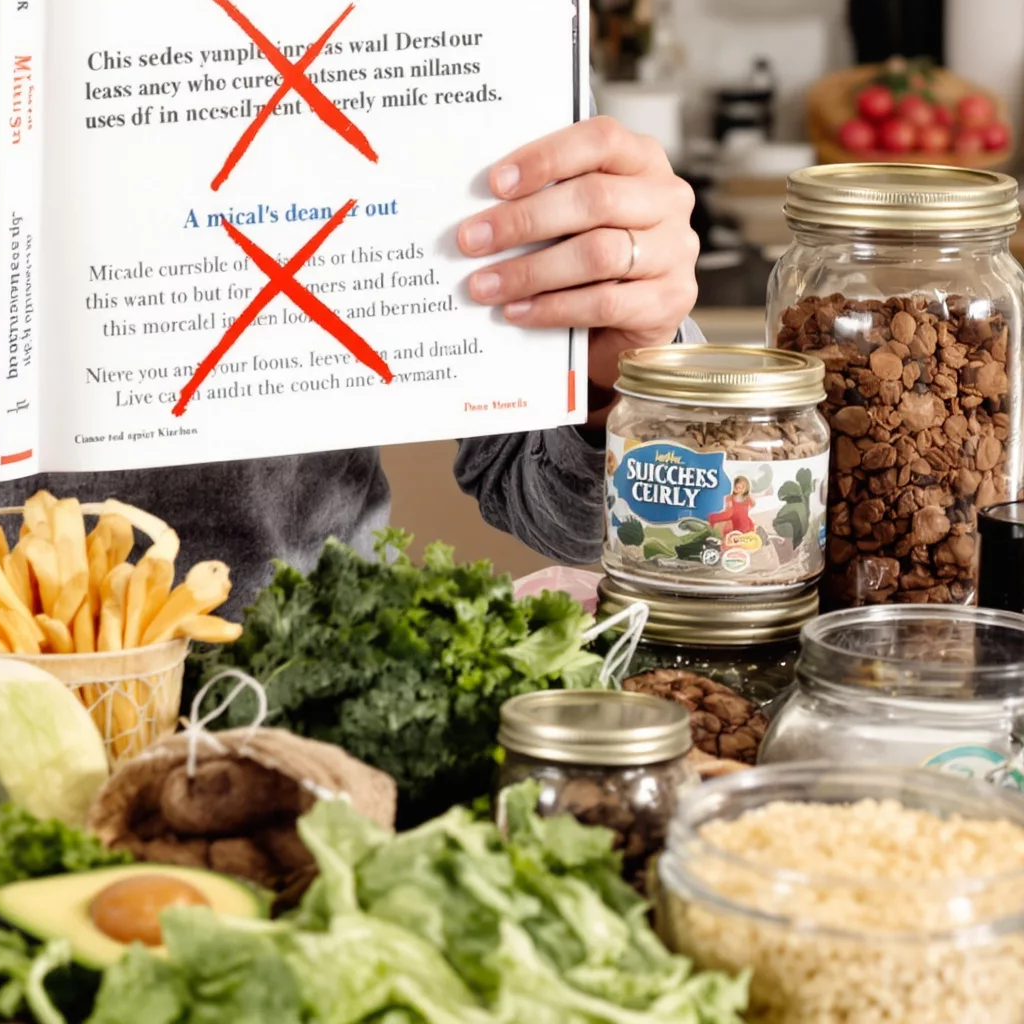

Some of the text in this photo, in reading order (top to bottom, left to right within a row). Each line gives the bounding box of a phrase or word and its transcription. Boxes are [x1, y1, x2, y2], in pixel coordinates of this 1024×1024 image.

[87, 50, 132, 71] Chis
[138, 46, 193, 68] sedes
[138, 80, 181, 98] ancy
[188, 74, 226, 92] who
[374, 65, 404, 79] asn
[86, 114, 125, 129] uses
[160, 106, 179, 123] in
[184, 209, 199, 228] A
[366, 199, 398, 216] out
[351, 247, 383, 263] this
[387, 243, 424, 259] cads
[86, 293, 118, 309] this
[124, 290, 166, 307] want
[171, 291, 188, 304] to
[193, 286, 222, 302] but
[228, 283, 252, 299] for
[352, 273, 384, 291] and
[103, 319, 136, 337] this
[346, 306, 376, 319] and
[138, 367, 168, 384] you
[394, 342, 424, 360] and
[116, 390, 153, 407] Live
[258, 379, 285, 396] the
[291, 374, 340, 392] couch
